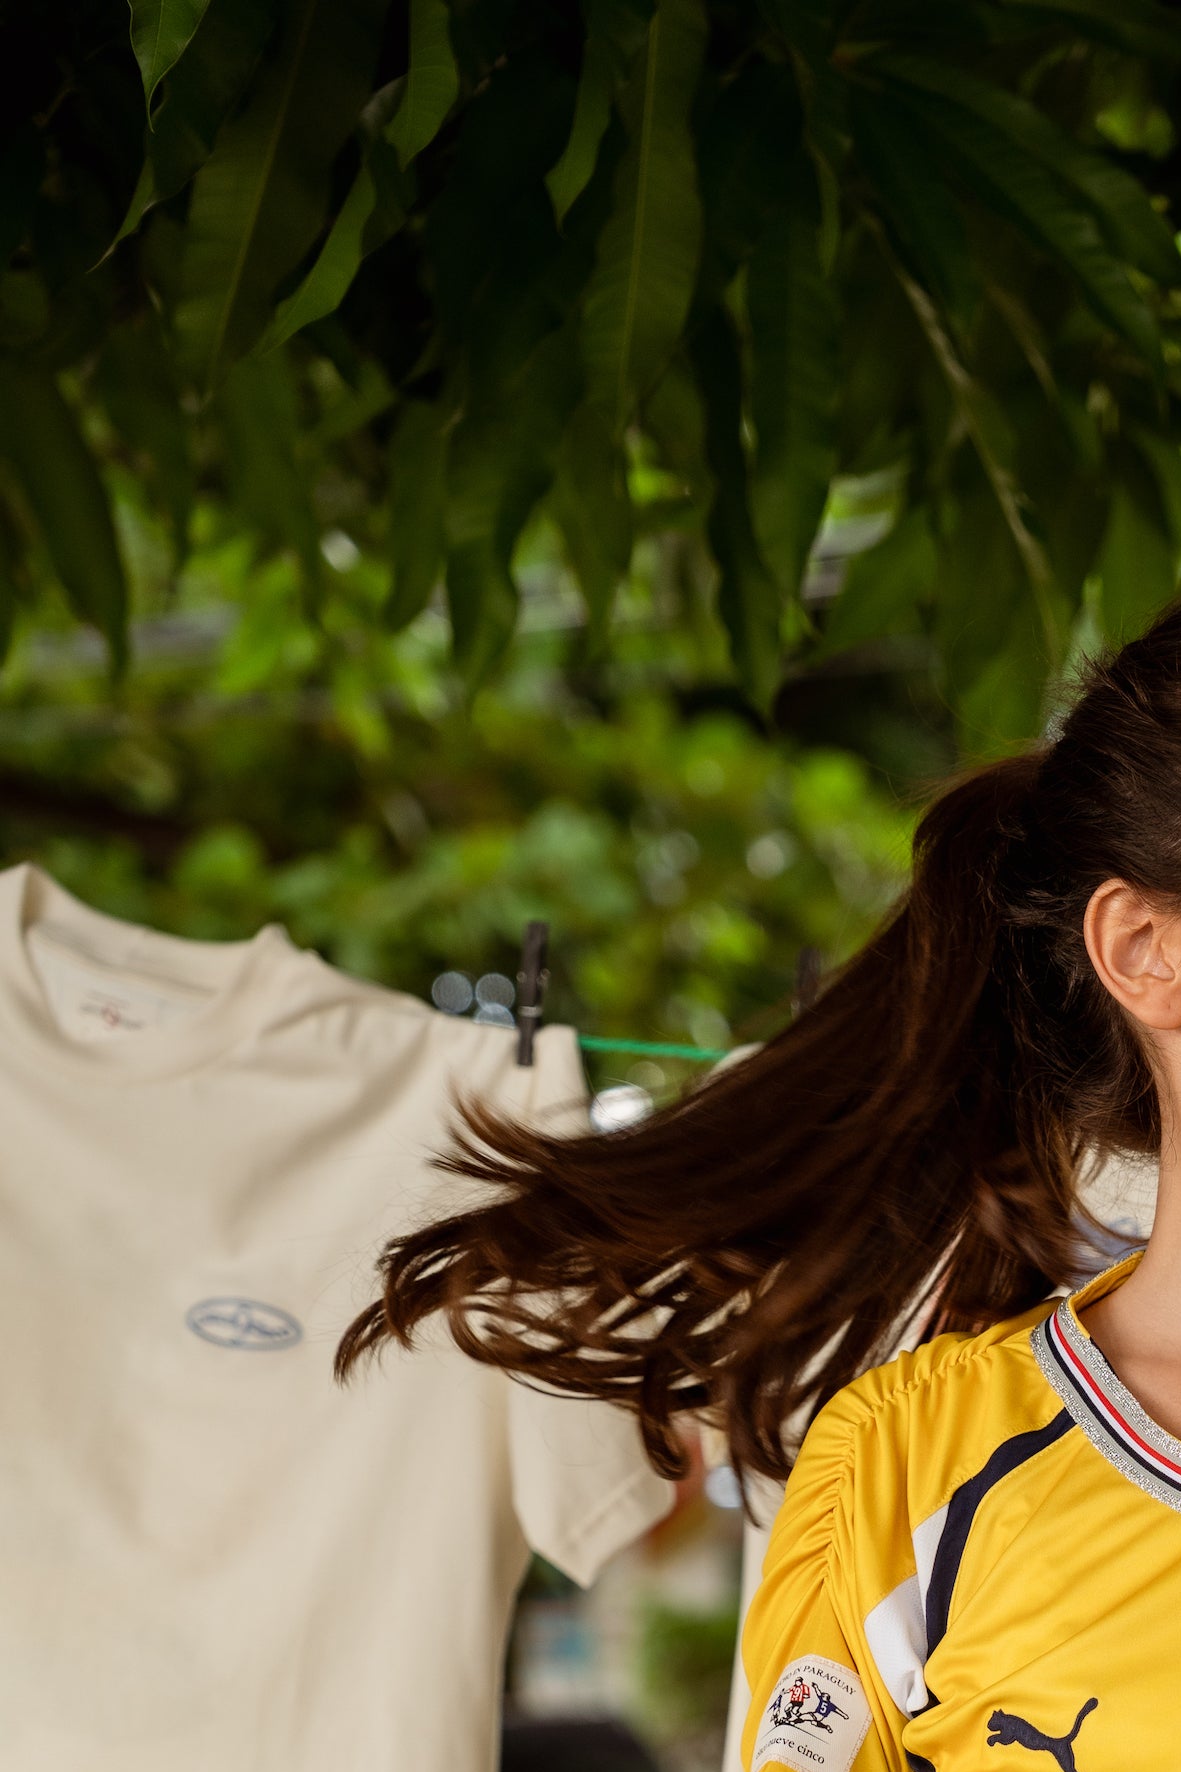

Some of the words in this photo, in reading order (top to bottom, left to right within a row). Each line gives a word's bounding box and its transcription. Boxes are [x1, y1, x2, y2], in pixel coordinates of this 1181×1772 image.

[803, 1665, 856, 1696] PARAGUAY
[820, 1702, 828, 1713] 5
[797, 1744, 825, 1764] cinco
